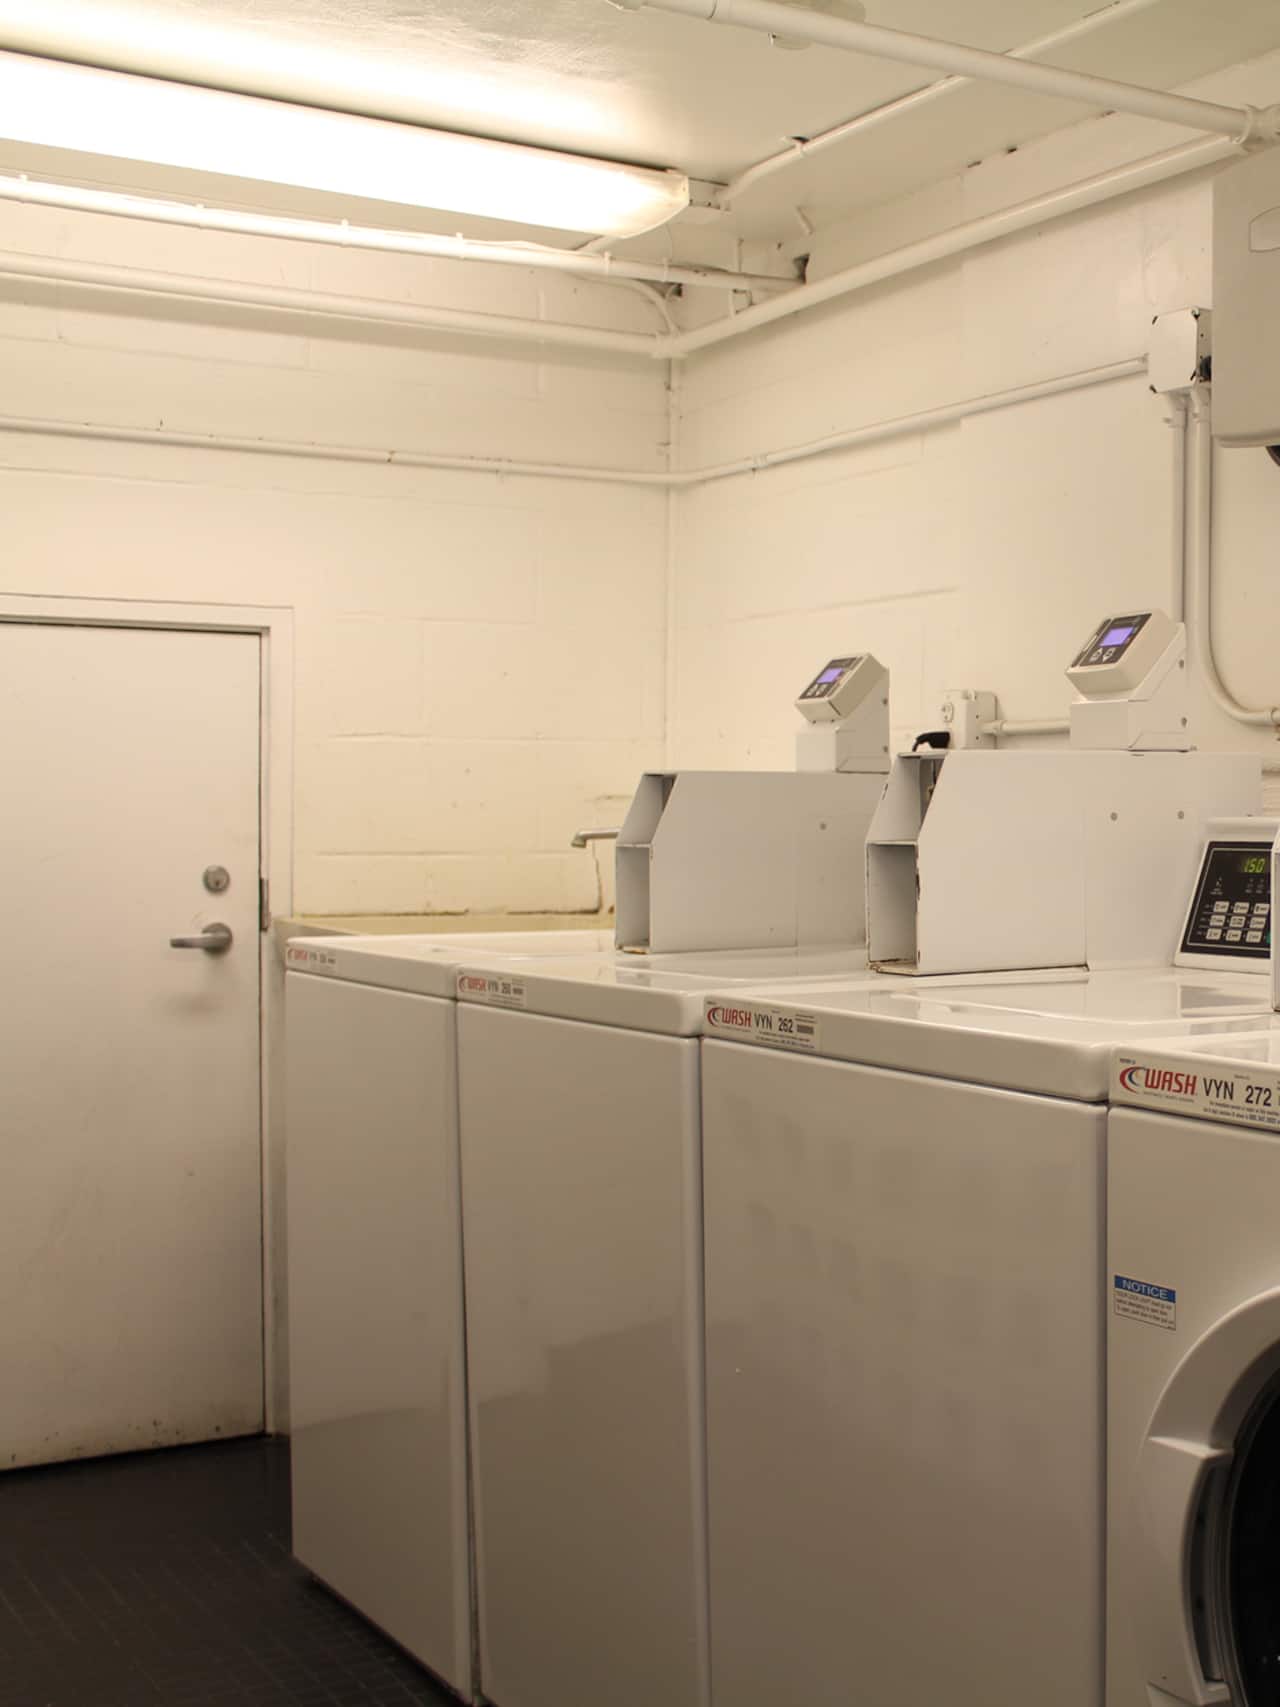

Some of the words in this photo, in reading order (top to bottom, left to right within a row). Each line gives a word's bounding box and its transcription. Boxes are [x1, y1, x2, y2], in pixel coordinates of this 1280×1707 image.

[721, 1007, 752, 1028] WASH
[754, 1013, 773, 1030] VYN
[1144, 1068, 1197, 1096] WASH
[1203, 1077, 1234, 1100] VYN
[1245, 1085, 1272, 1107] 272
[1122, 1279, 1169, 1299] NOTICE
